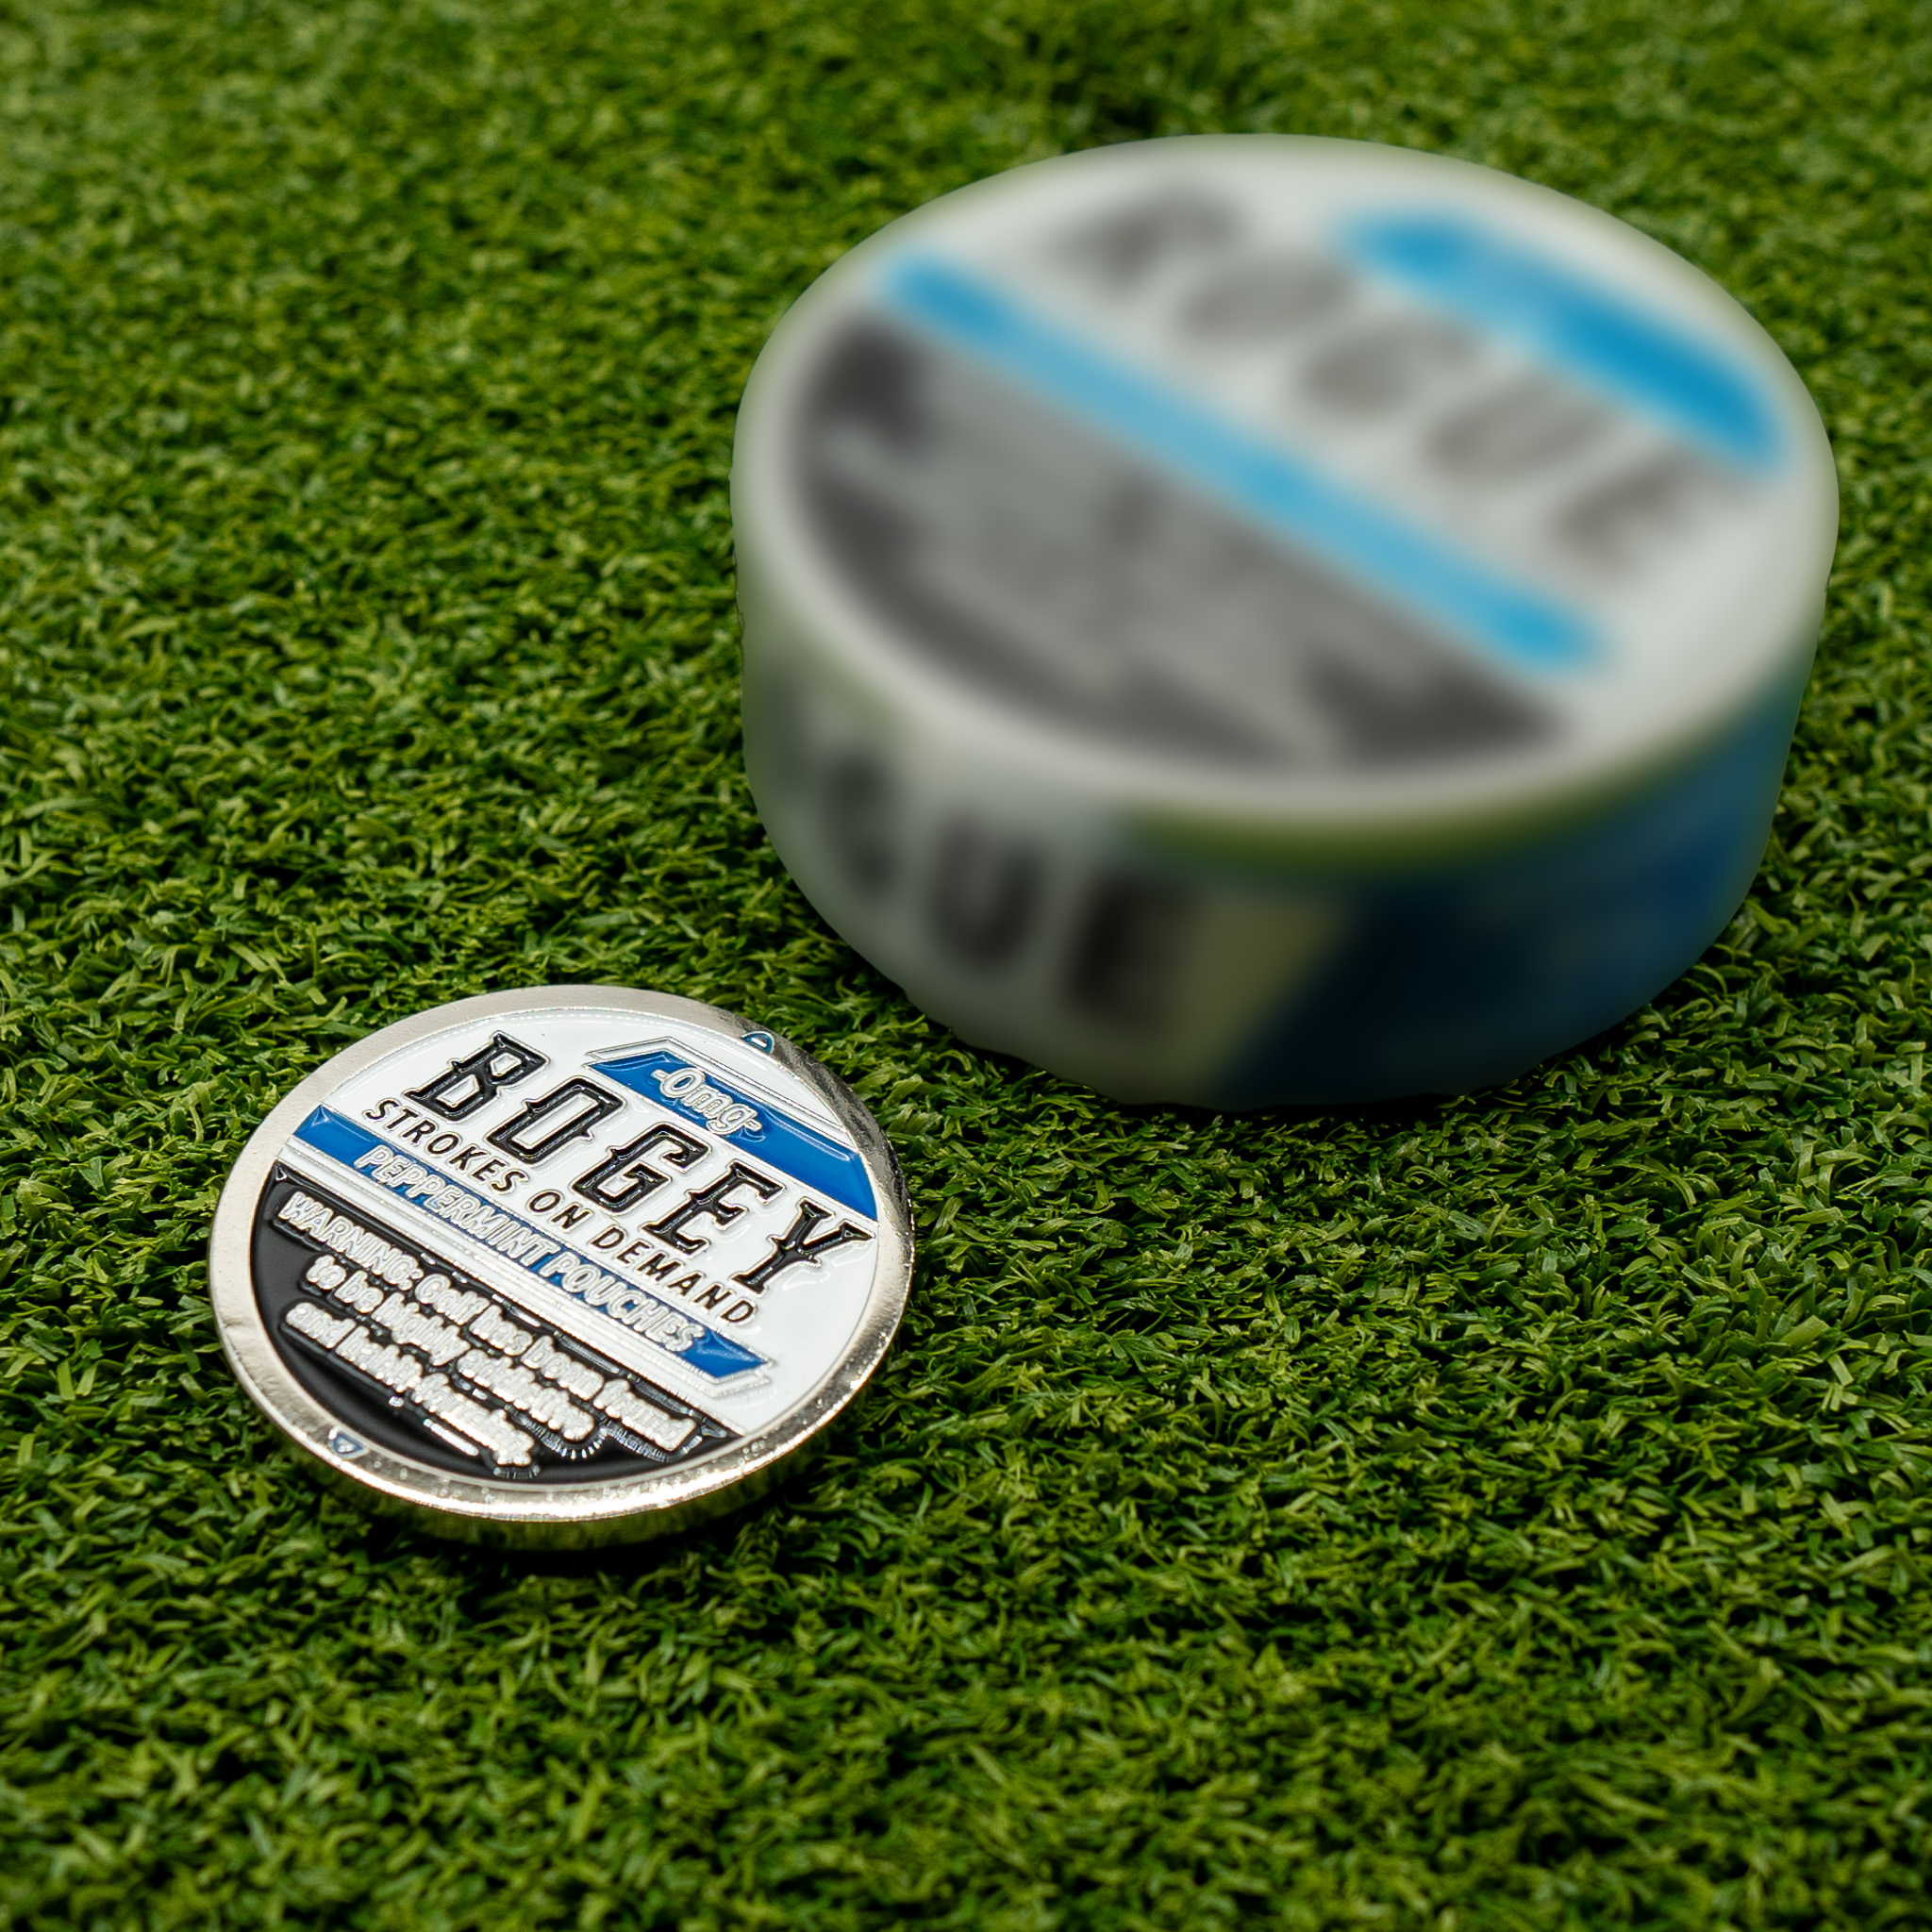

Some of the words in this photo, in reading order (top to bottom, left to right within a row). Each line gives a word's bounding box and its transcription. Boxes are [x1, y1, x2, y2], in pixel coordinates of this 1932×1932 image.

[354, 1144, 563, 1266] PEPPERMINT
[539, 1252, 704, 1353] POUCHES
[362, 1096, 530, 1195] STROKES
[527, 1189, 592, 1230] ON
[589, 1225, 758, 1326] DEMAND
[404, 1030, 875, 1296] BOGEY
[277, 1191, 424, 1291] WARNING:
[414, 1273, 491, 1325] Golf
[468, 1304, 533, 1356] has
[521, 1335, 604, 1401] been
[286, 1301, 355, 1349] and
[305, 1254, 347, 1291] to
[333, 1275, 384, 1313] be
[371, 1291, 471, 1367] highly
